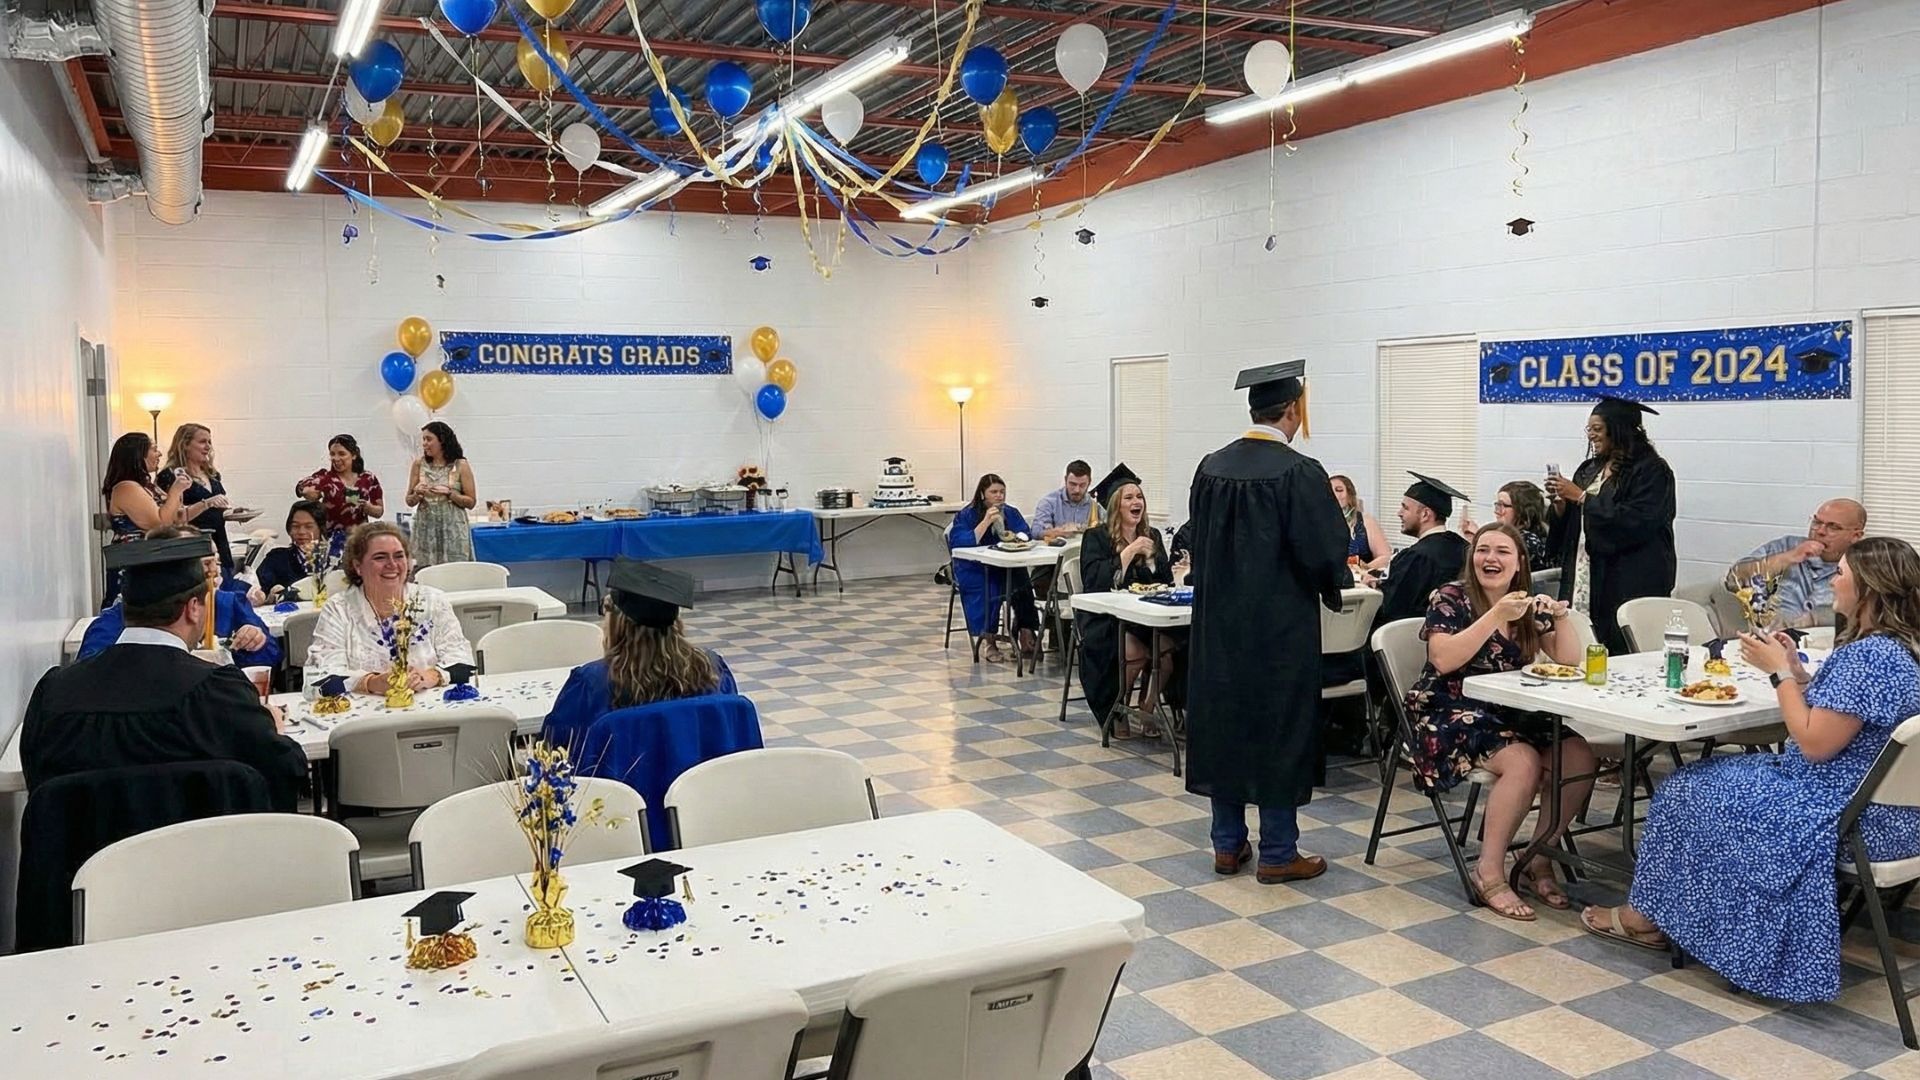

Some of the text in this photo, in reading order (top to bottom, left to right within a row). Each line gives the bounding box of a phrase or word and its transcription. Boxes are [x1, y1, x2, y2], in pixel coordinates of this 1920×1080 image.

[478, 344, 700, 366] CONGRATS GRADS
[1518, 345, 1789, 388] CLASS OF 2024
